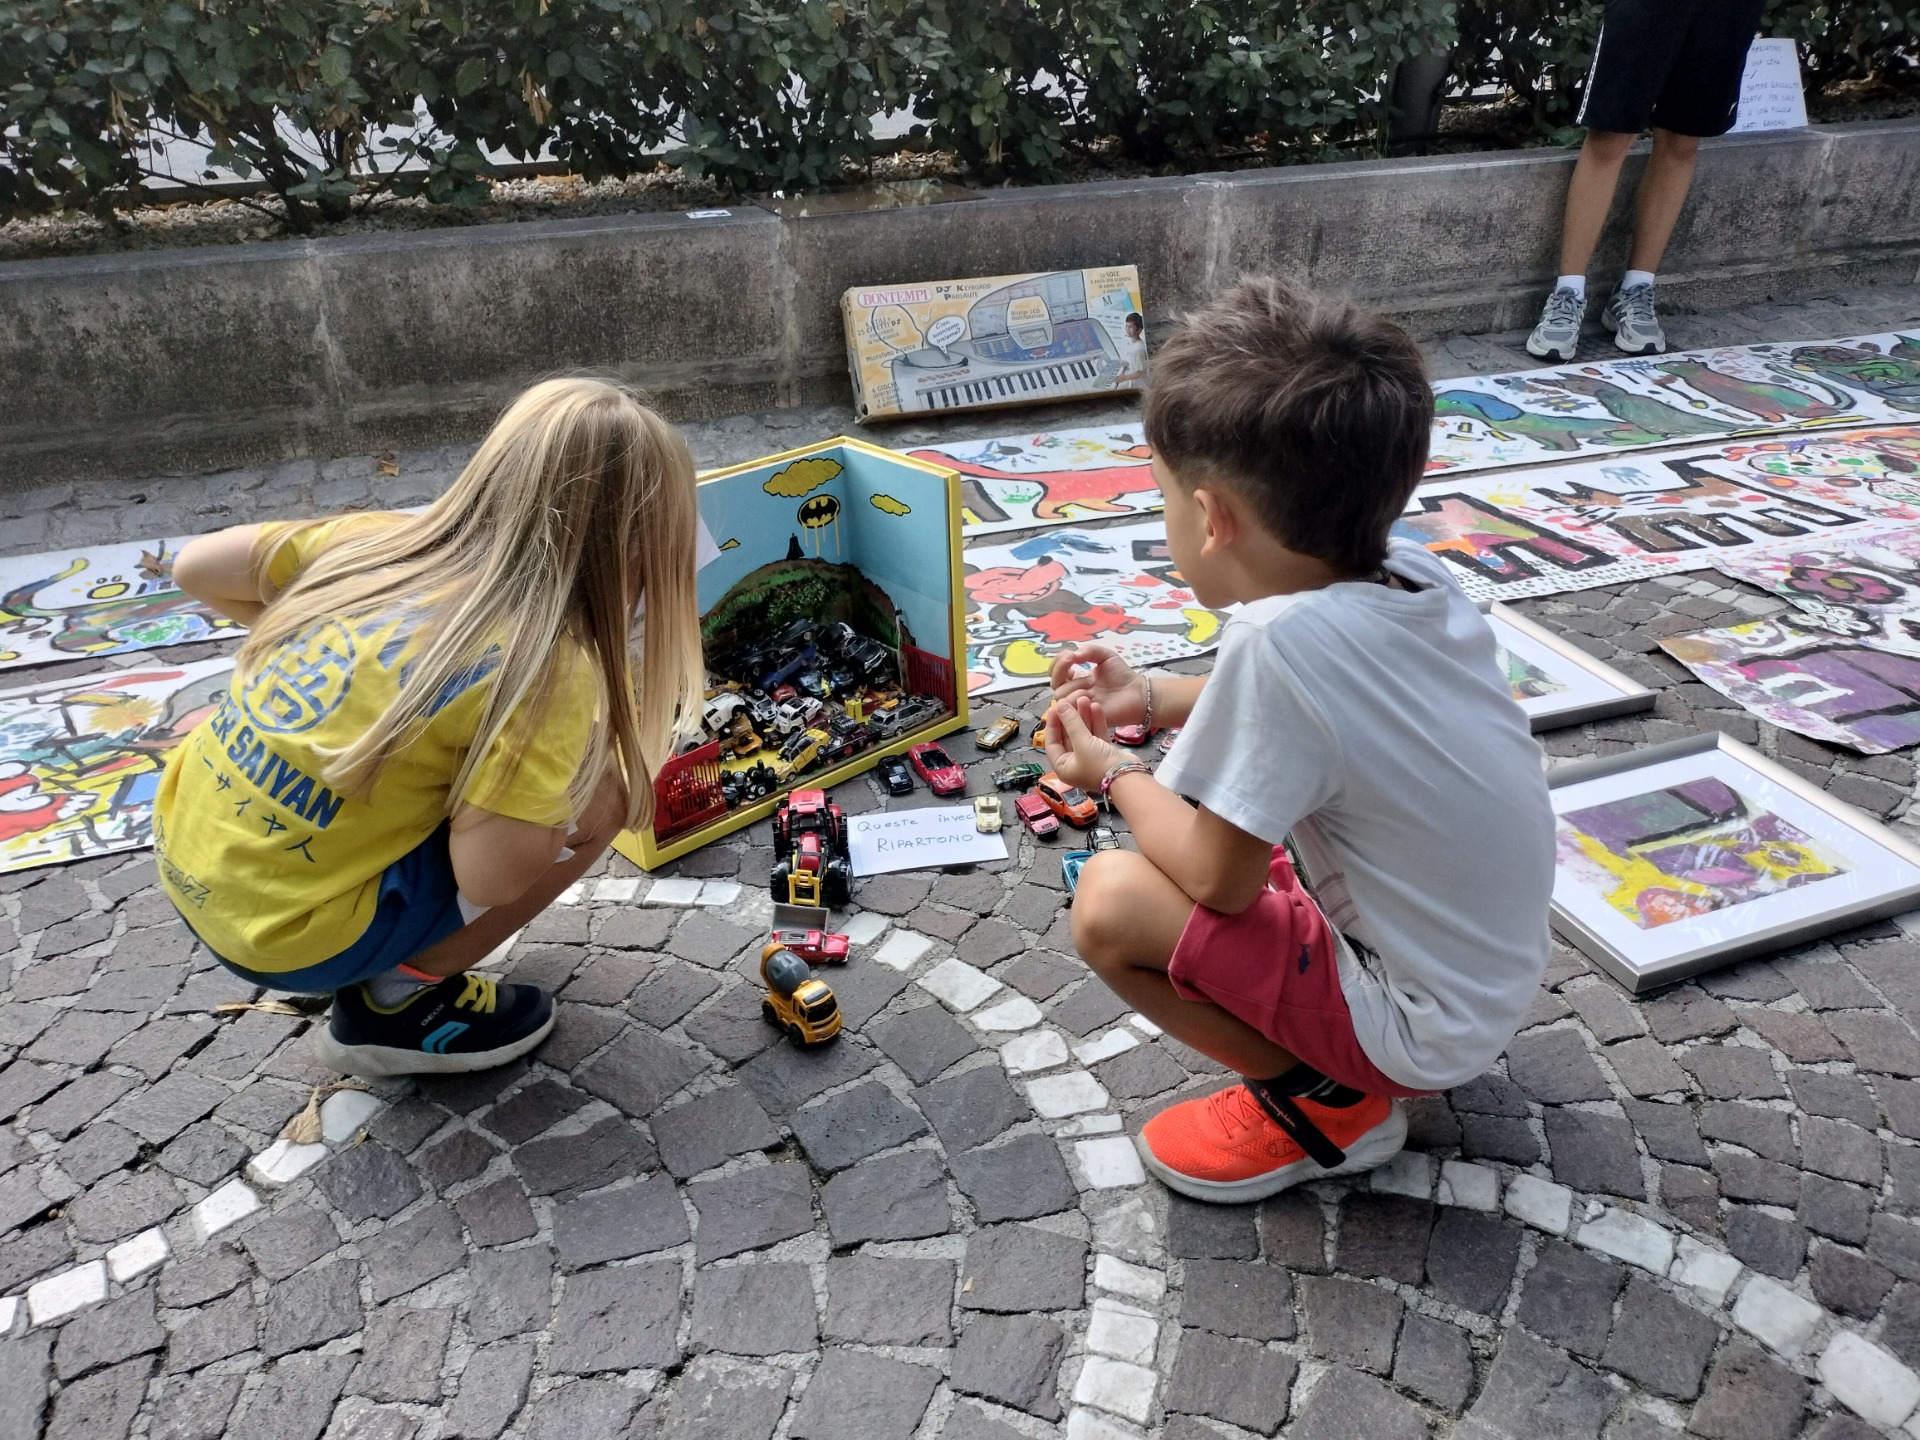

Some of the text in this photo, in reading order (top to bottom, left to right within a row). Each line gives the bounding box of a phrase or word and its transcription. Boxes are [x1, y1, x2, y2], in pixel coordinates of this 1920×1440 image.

[863, 289, 928, 306] BONTEMPI
[936, 286, 952, 294] DJ
[932, 322, 960, 338] suoniamo
[936, 328, 961, 344] insieme?
[866, 350, 894, 362] Microfono
[227, 725, 345, 830] SAIYAN
[857, 813, 977, 832] Queste invec
